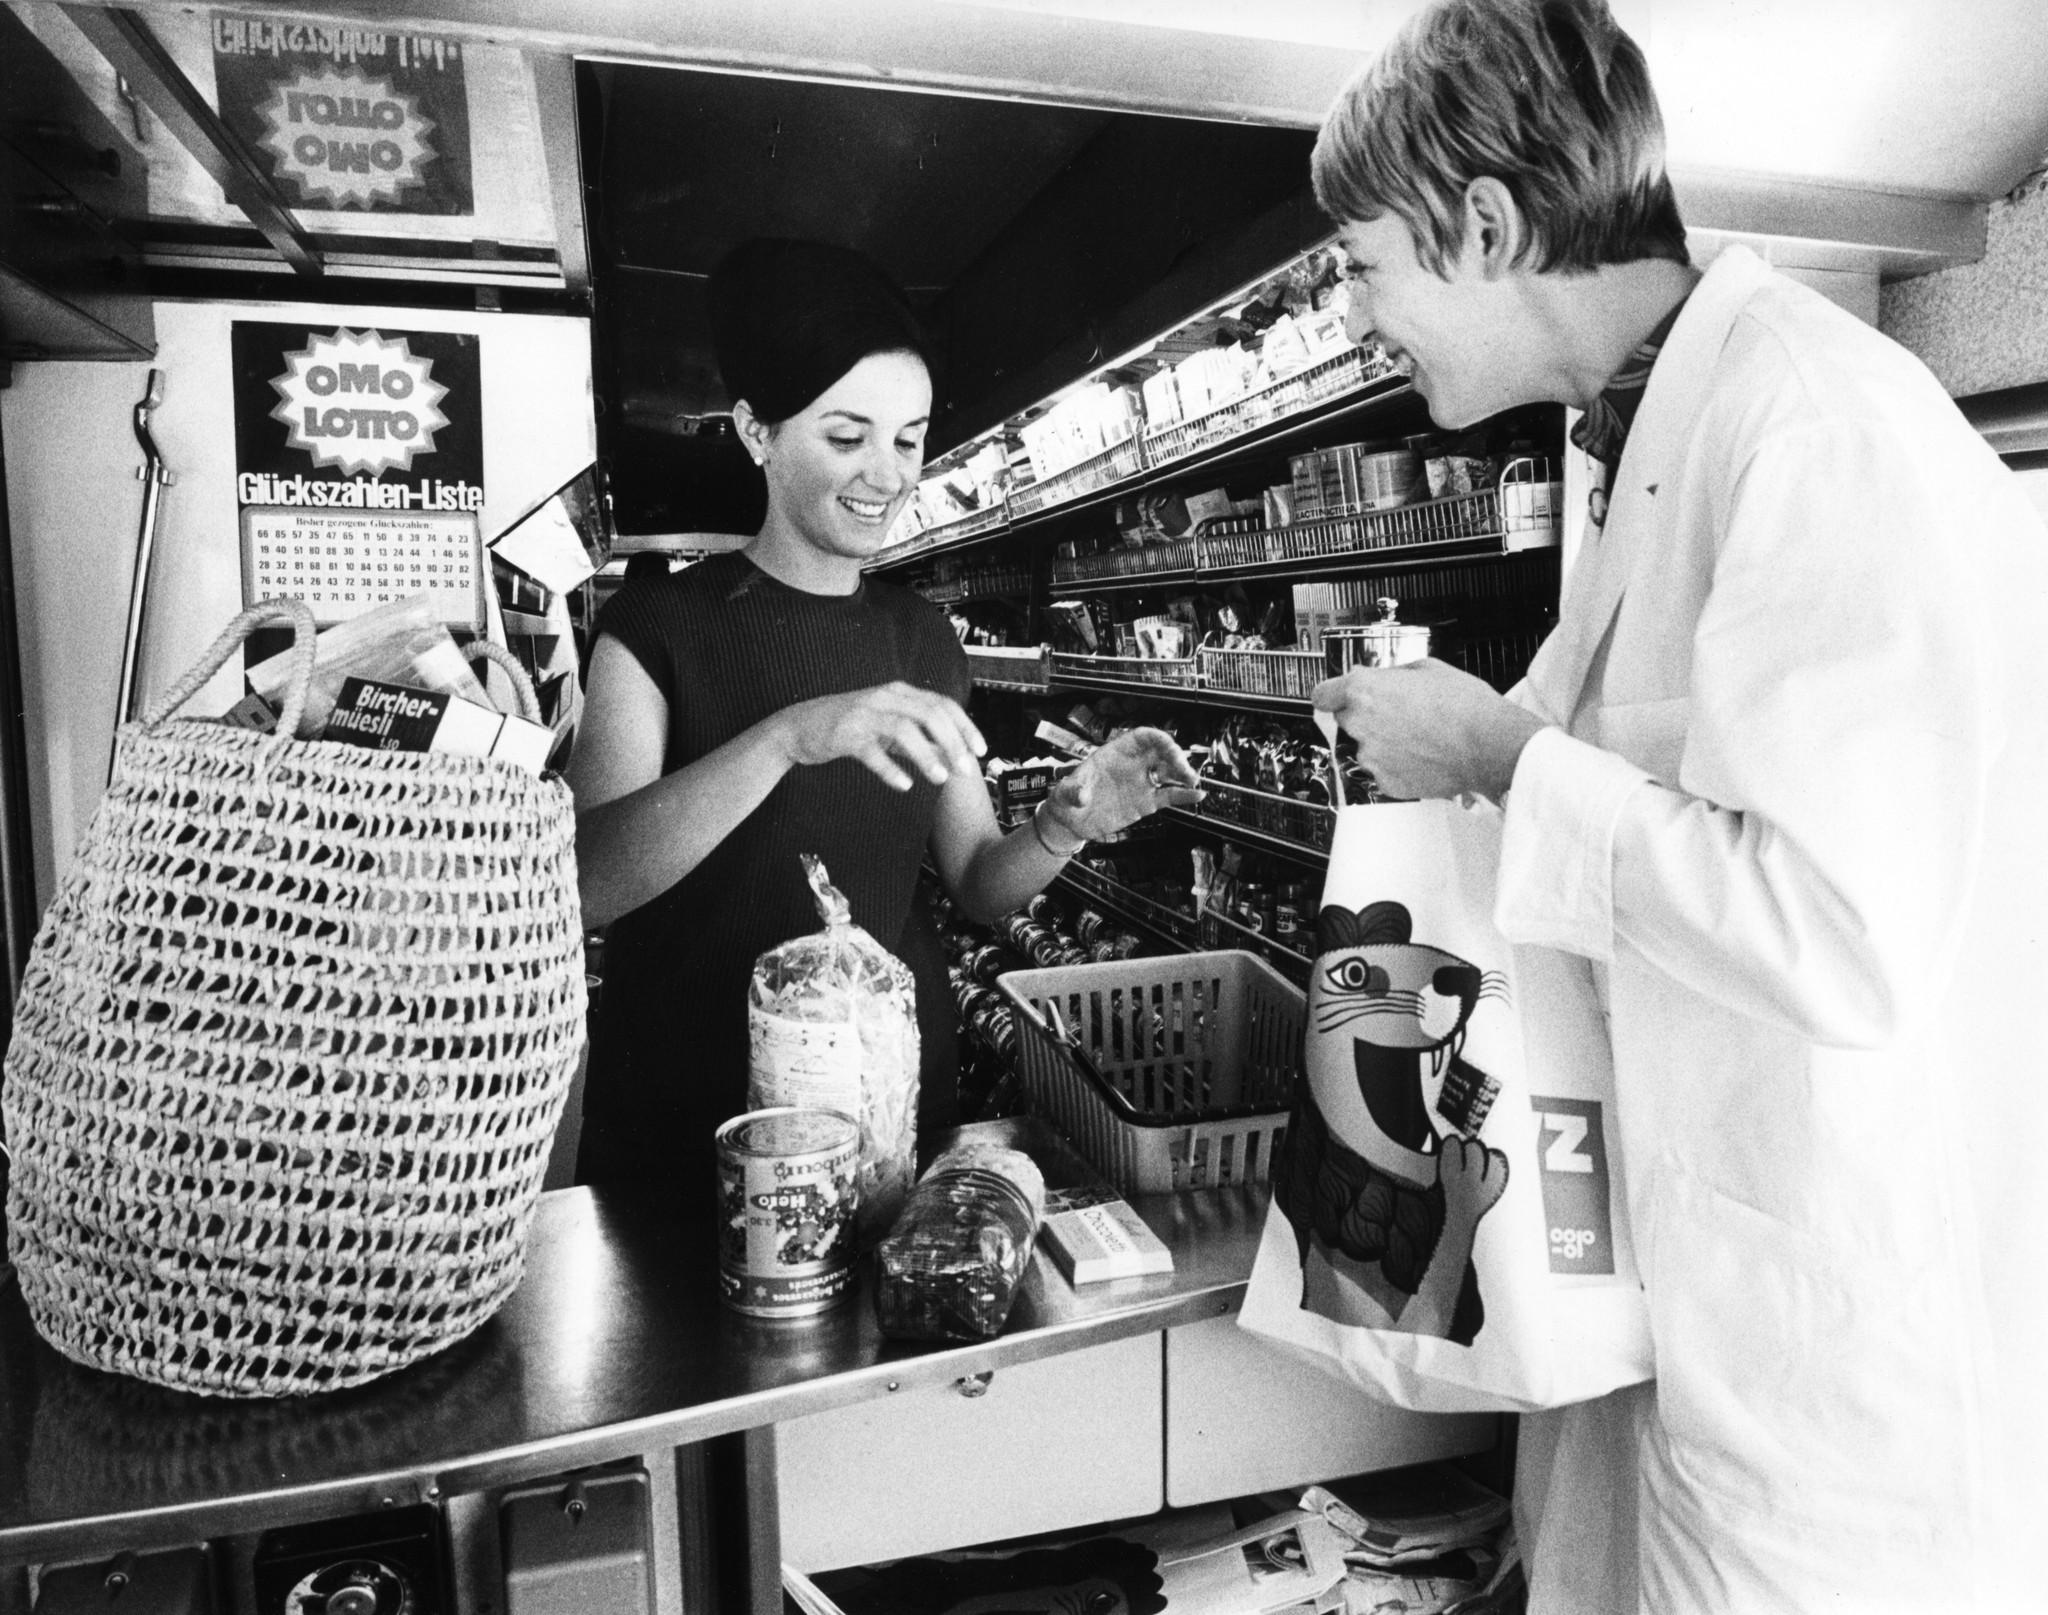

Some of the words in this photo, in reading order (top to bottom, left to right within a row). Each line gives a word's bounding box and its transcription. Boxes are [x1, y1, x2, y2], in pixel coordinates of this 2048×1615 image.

[305, 362, 414, 400] OMO
[304, 407, 419, 441] LOTTO
[238, 472, 484, 511] Glückszahlen-Liste
[296, 517, 324, 526] Bisher
[258, 530, 268, 538] 66
[275, 530, 286, 538] 85
[292, 530, 302, 539] 57
[309, 531, 319, 539] 35
[343, 532, 353, 540] 65
[377, 533, 387, 541] 50
[459, 535, 468, 543] 23
[261, 545, 269, 553] 19
[276, 546, 286, 554] 40
[294, 546, 303, 554] 51
[344, 547, 354, 555] 30
[443, 550, 453, 558] 46
[459, 550, 468, 558] 56
[259, 561, 270, 569] 28
[276, 561, 286, 569] 32
[310, 562, 320, 570] 68
[361, 563, 371, 571] 84
[427, 564, 437, 573] 90
[444, 565, 453, 573] 37
[459, 565, 469, 573] 82
[261, 576, 270, 584] 76
[276, 577, 287, 585] 42
[293, 577, 304, 585] 54
[311, 577, 321, 585] 26
[327, 578, 337, 586] 43
[346, 578, 354, 586] 72
[361, 578, 371, 586] 38
[378, 579, 388, 587] 58
[396, 579, 404, 587] 31
[444, 580, 454, 588] 36
[460, 580, 469, 588] 52
[294, 592, 304, 601] 53
[313, 593, 321, 601] 12
[345, 593, 355, 601] 83
[356, 685, 439, 719] Bircher-
[330, 706, 396, 736] müesli
[758, 1193, 807, 1211] Hero
